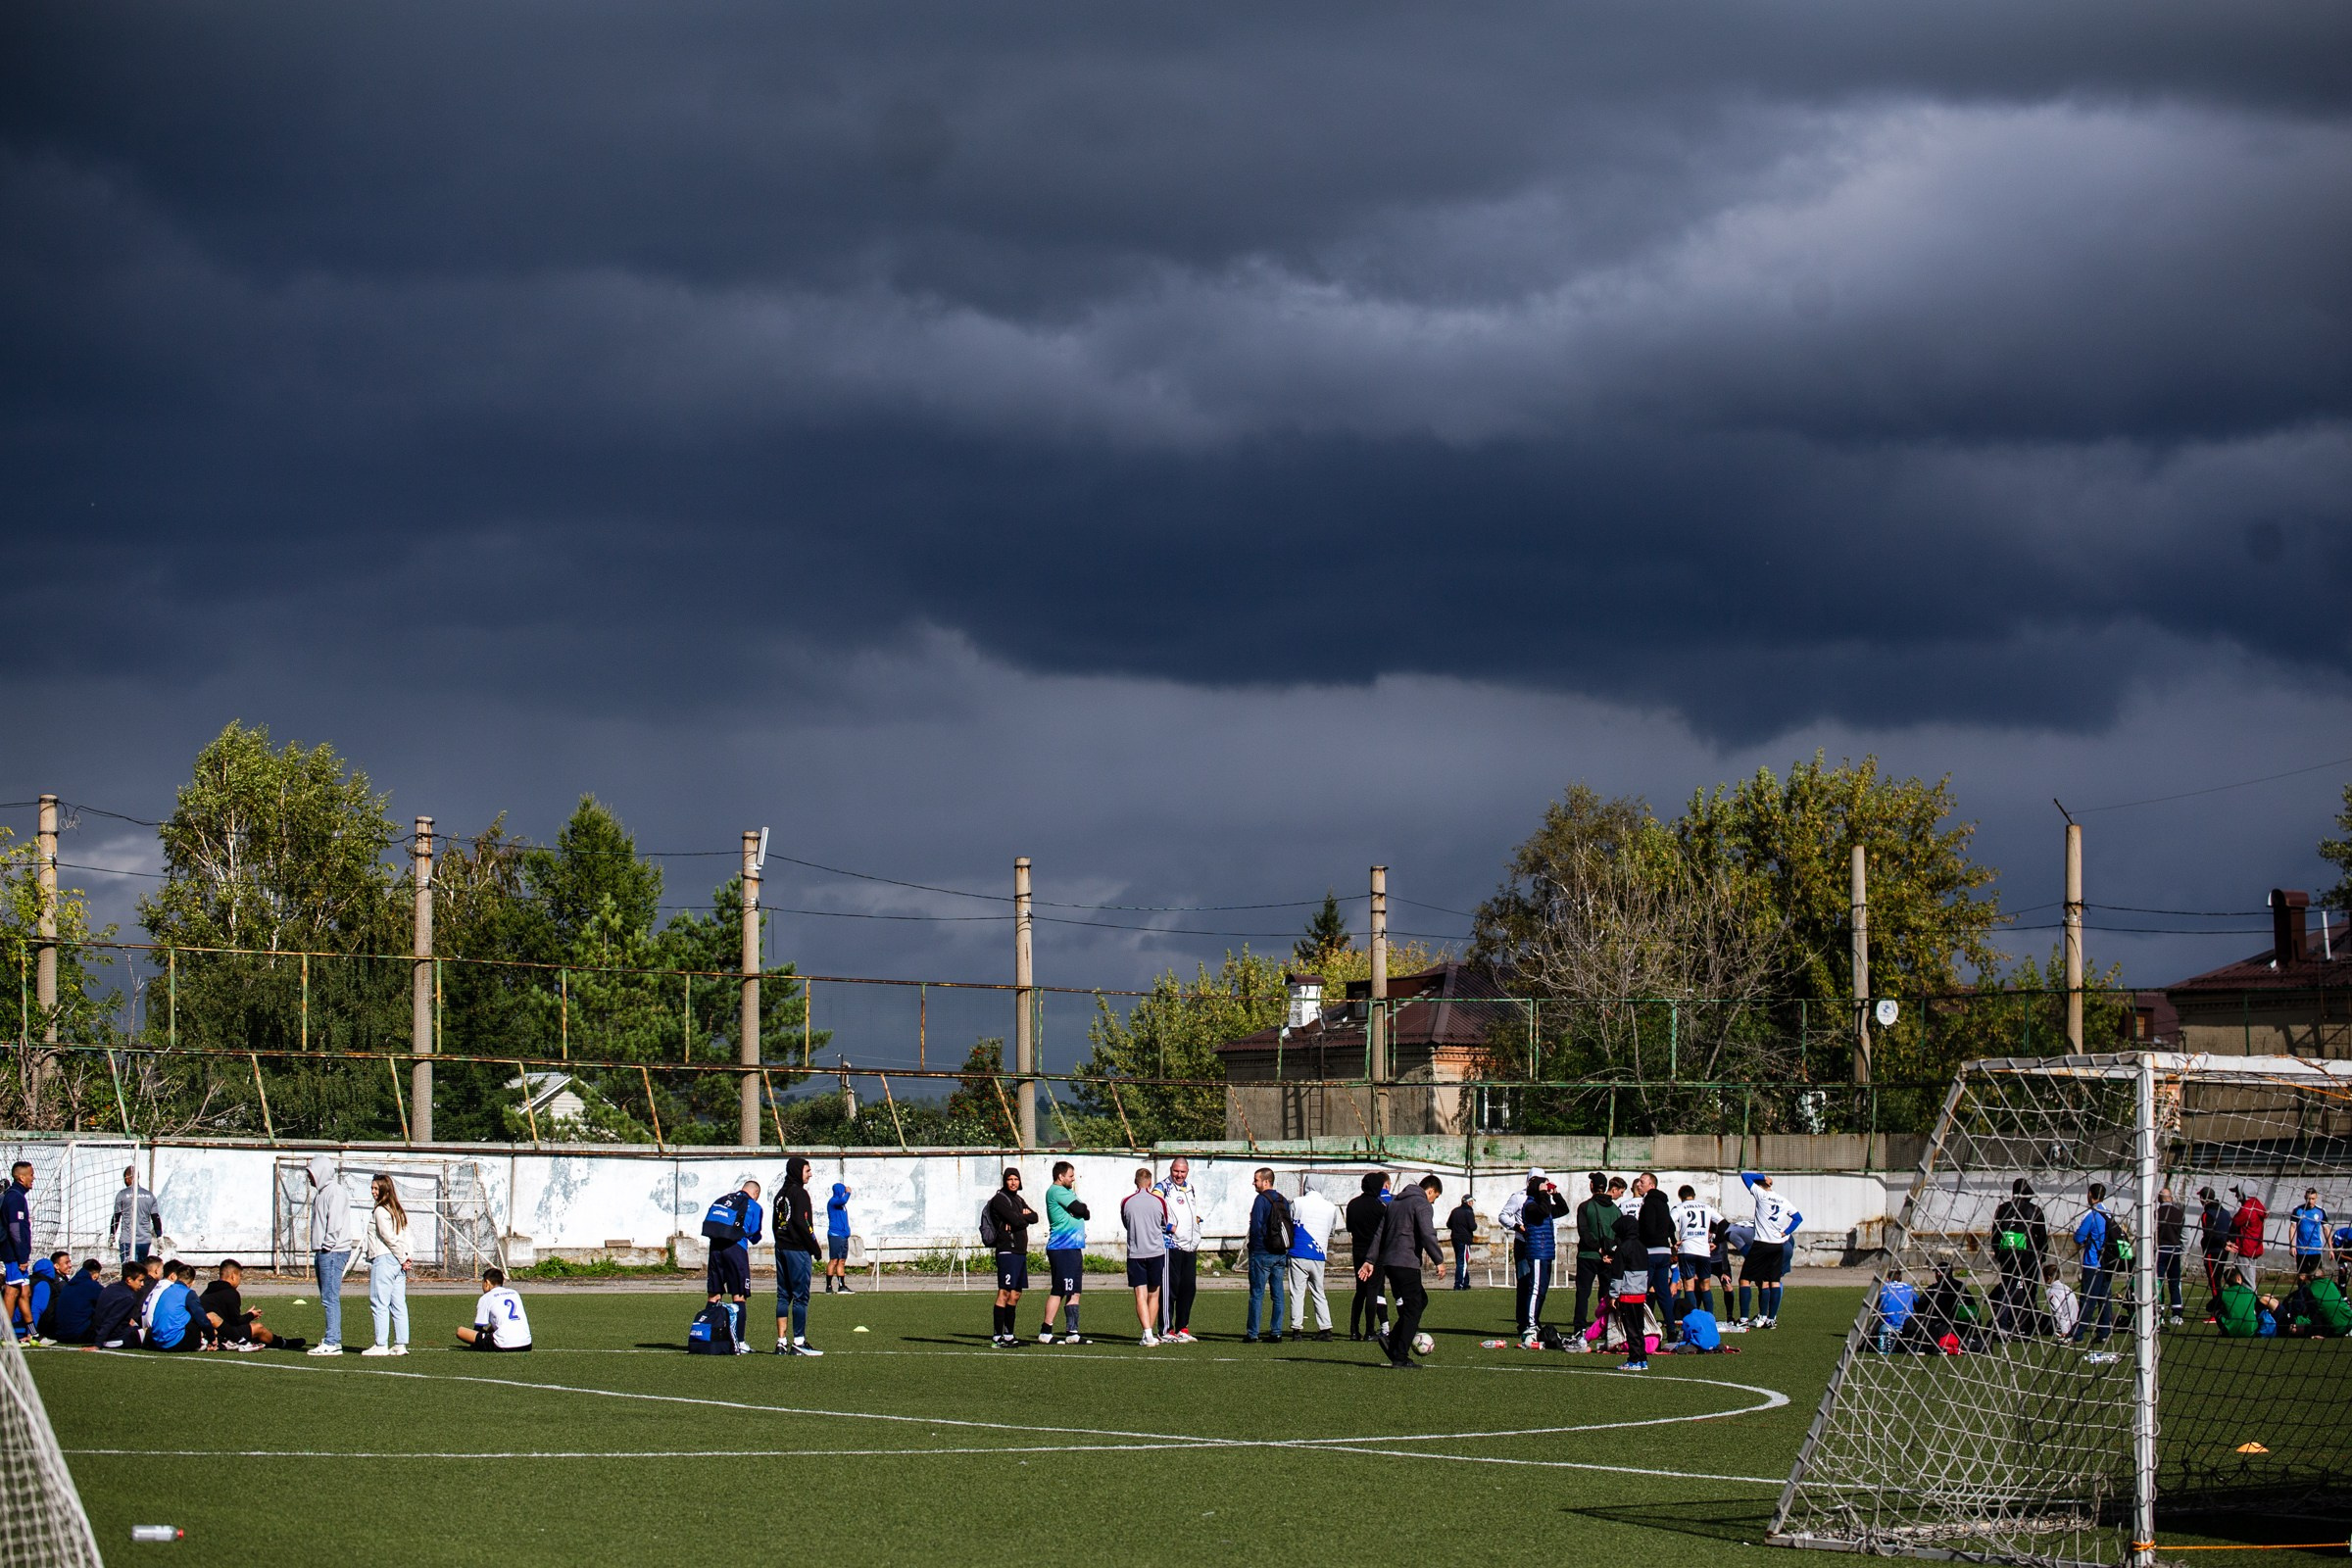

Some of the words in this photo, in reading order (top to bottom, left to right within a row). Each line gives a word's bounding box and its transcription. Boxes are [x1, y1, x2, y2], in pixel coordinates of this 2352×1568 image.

[1687, 1210, 1706, 1229] 21
[1767, 1203, 1780, 1222] 2
[2008, 1236, 2015, 1247] 3
[1004, 1274, 1011, 1285] 2
[1063, 1278, 1074, 1291] 13
[504, 1298, 520, 1321] 2
